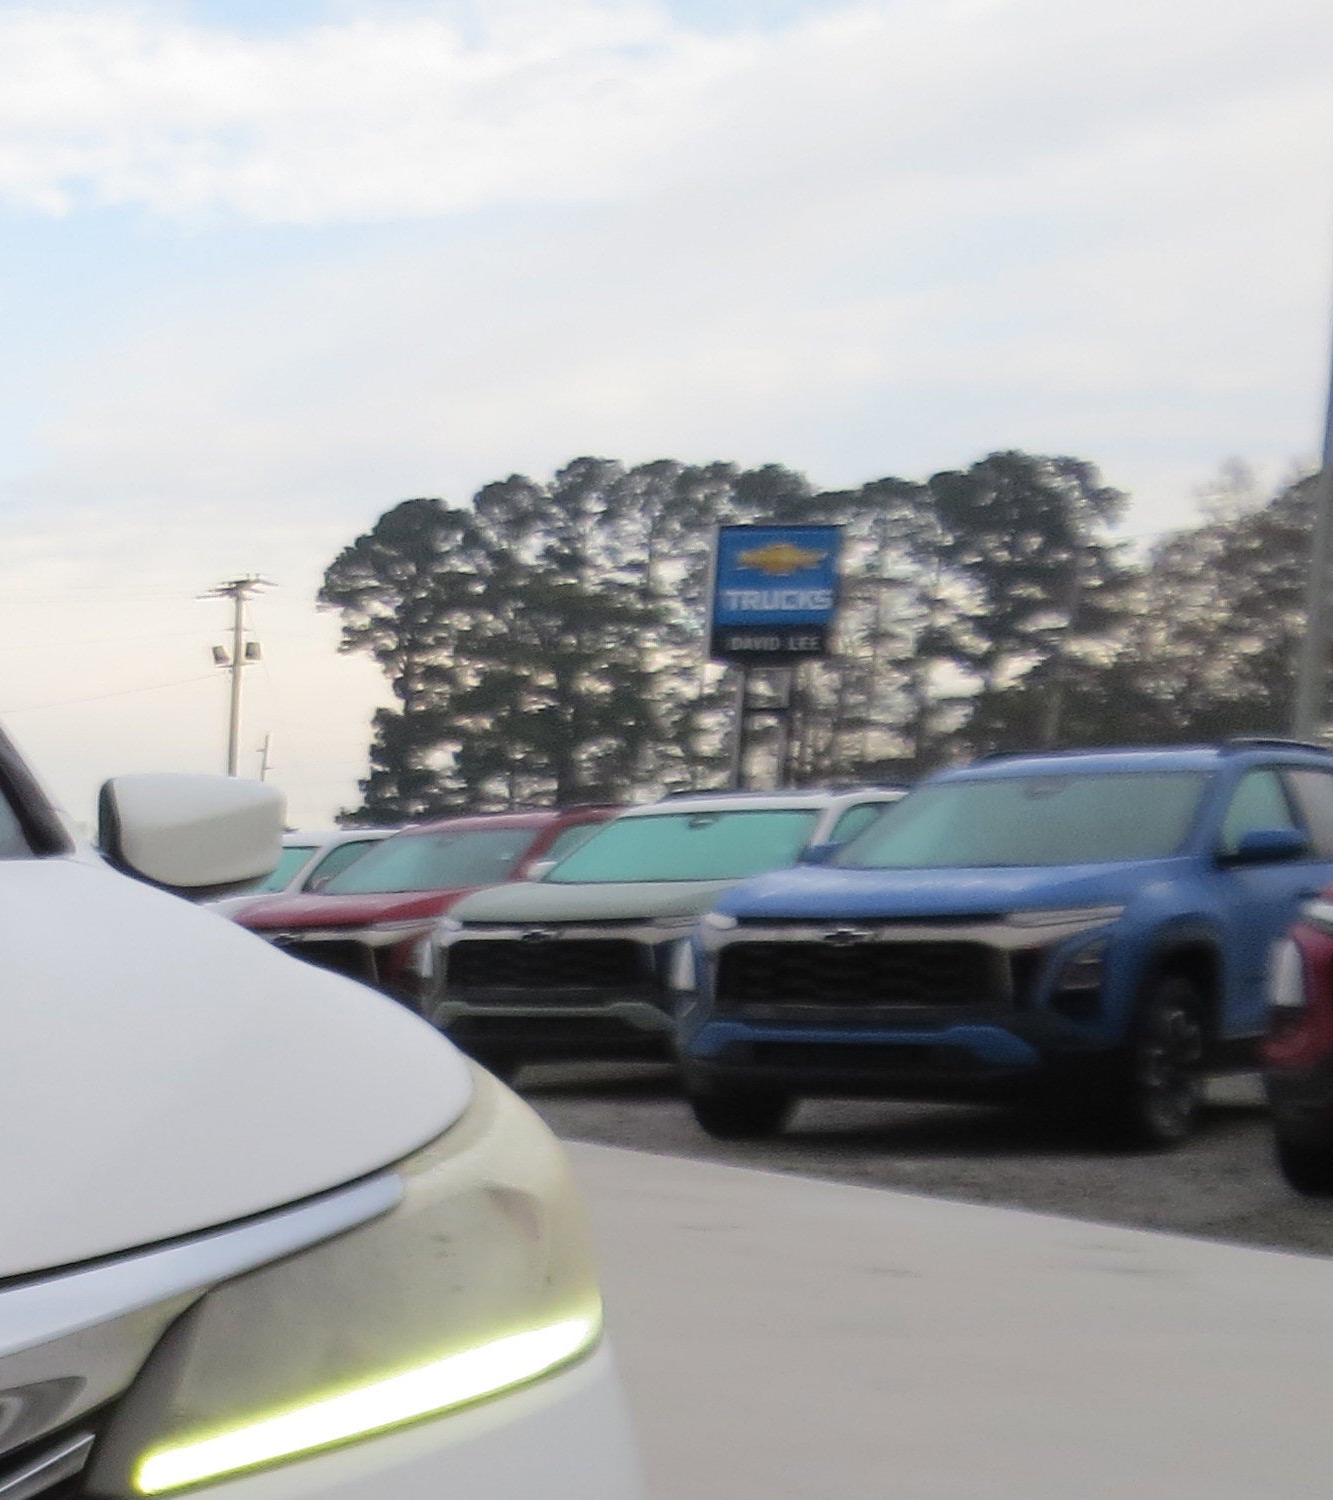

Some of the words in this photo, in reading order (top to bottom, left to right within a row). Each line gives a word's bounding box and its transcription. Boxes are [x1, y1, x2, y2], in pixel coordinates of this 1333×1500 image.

[725, 589, 833, 611] TRUCKS
[730, 636, 780, 651] DAVID
[788, 636, 821, 651] LEE
